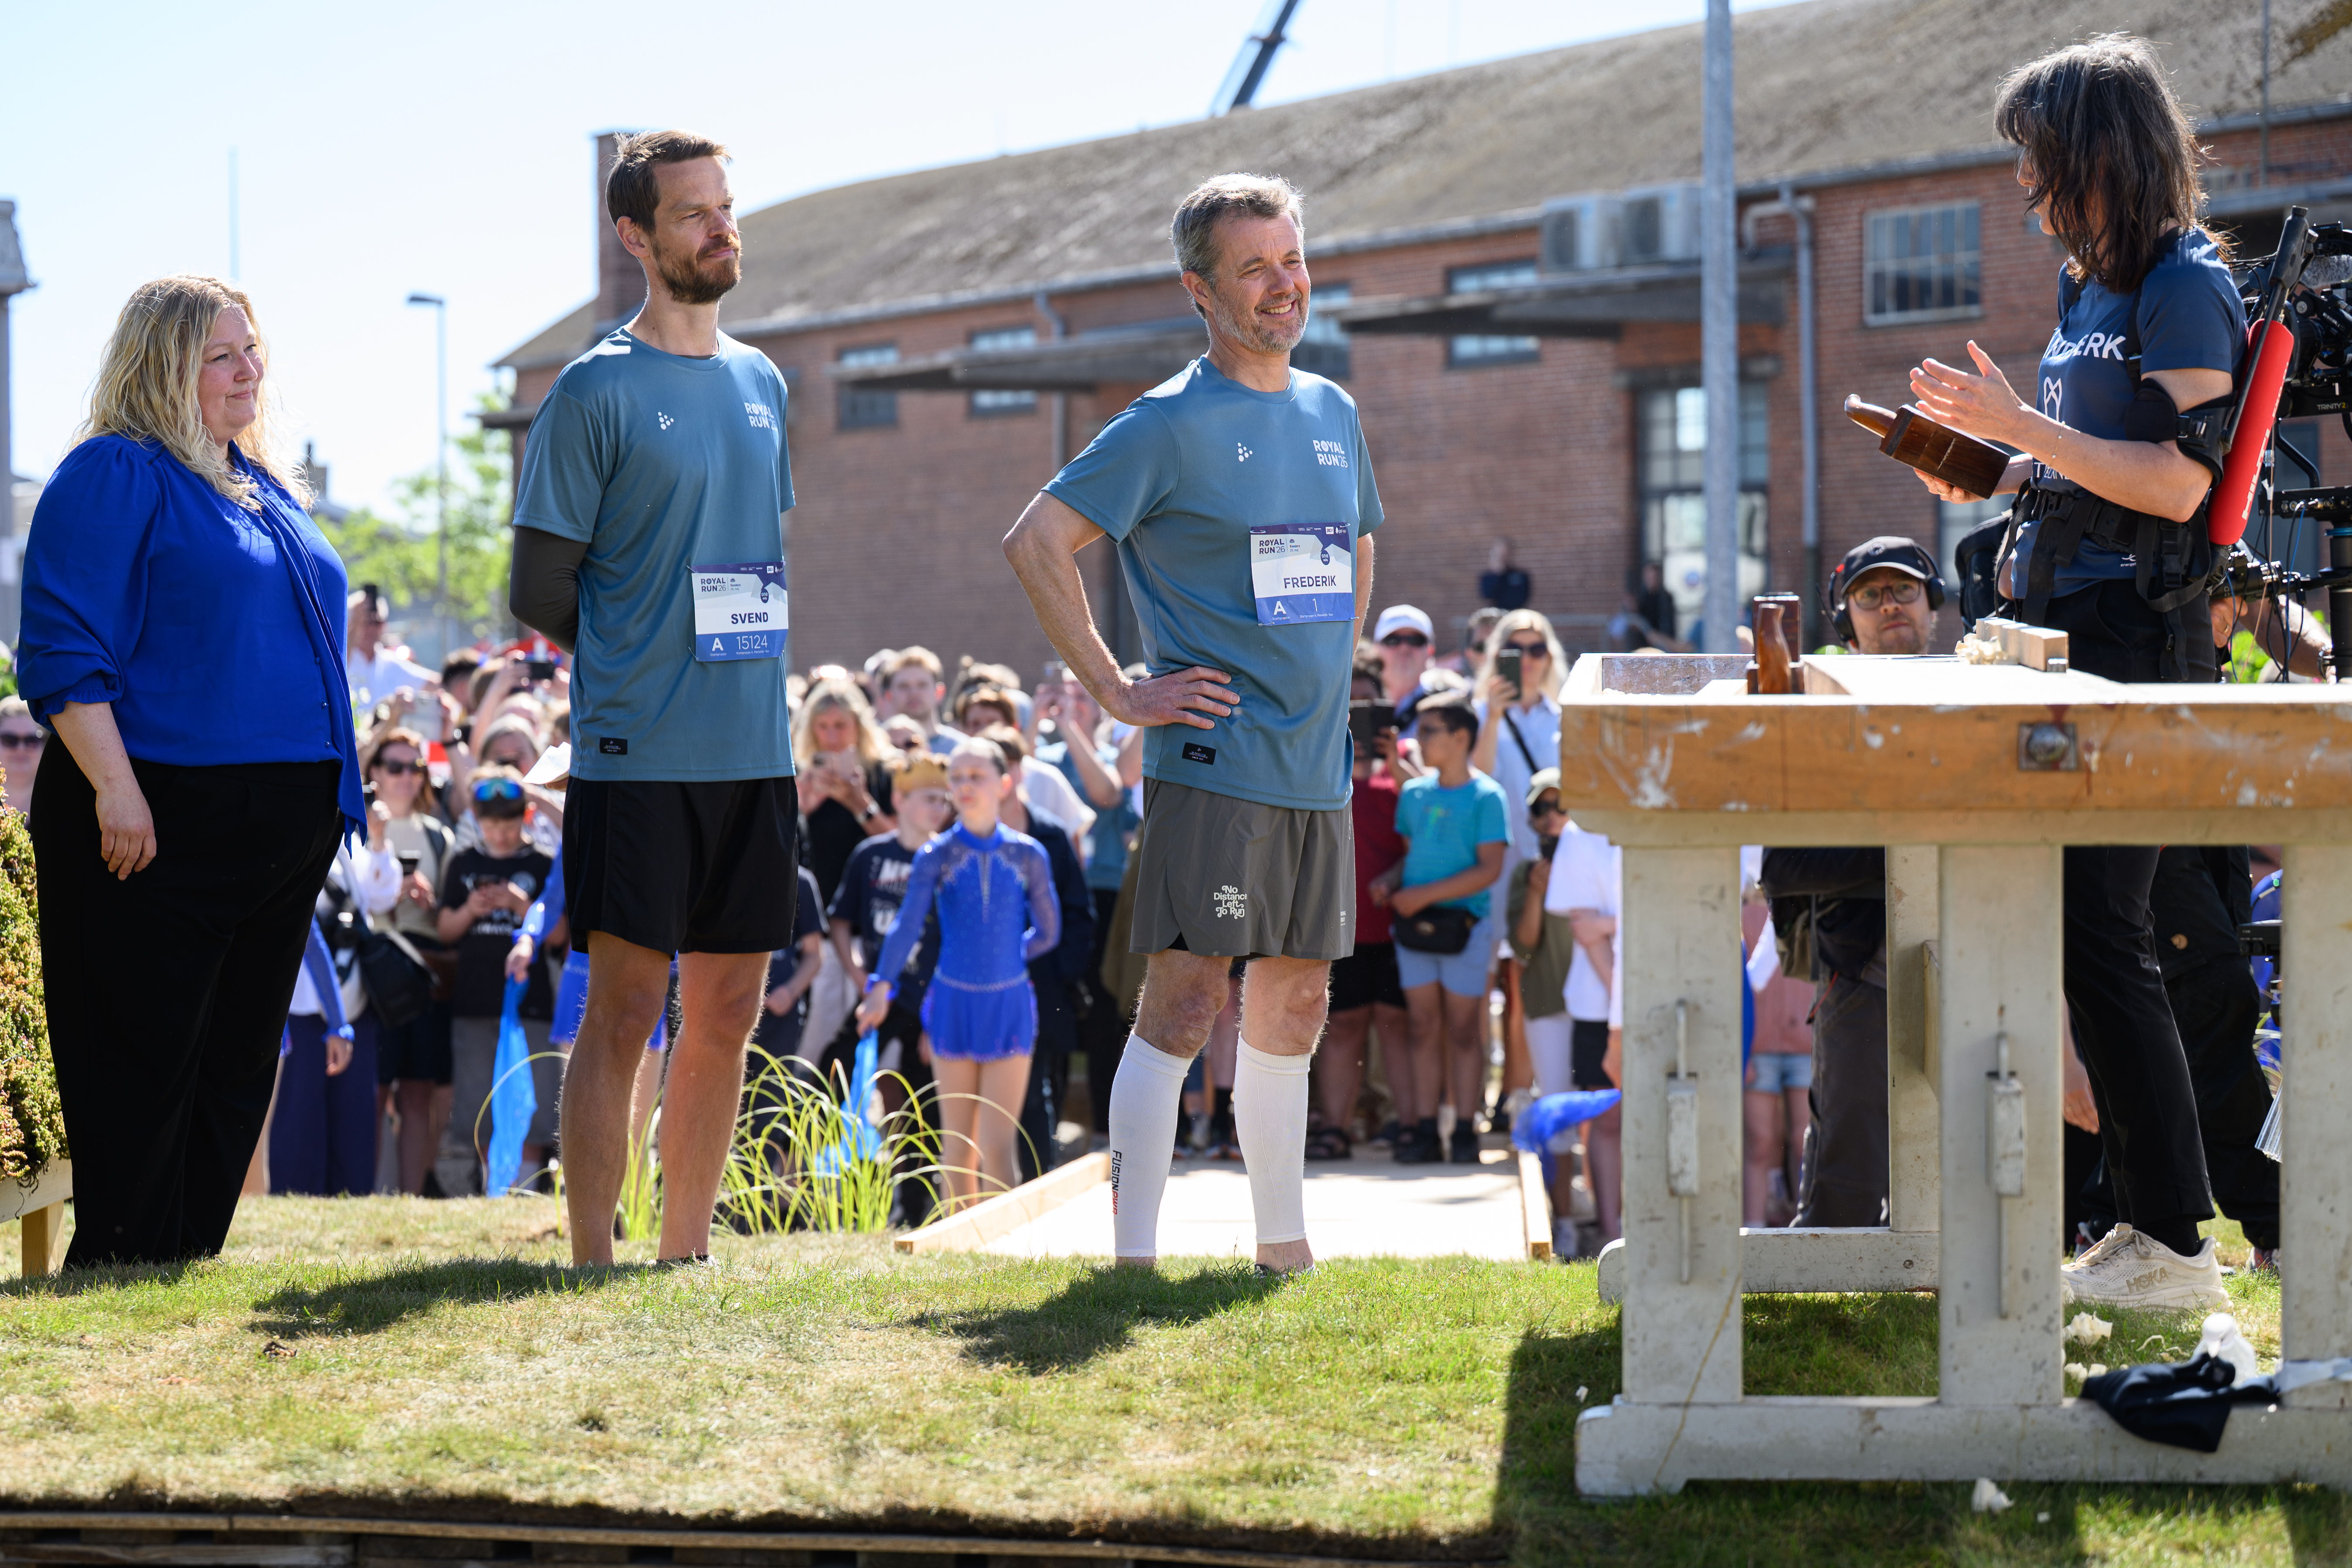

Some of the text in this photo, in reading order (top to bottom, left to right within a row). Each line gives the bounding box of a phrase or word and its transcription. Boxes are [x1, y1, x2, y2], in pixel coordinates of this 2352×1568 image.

[744, 402, 774, 419] ROYAL
[1312, 440, 1345, 455] ROYAL
[2241, 428, 2270, 520] HILTI
[1284, 575, 1337, 589] FREDERIK
[1274, 598, 1318, 615] A 1
[731, 612, 768, 624] SVEND
[712, 635, 768, 651] A 15124
[1214, 892, 1247, 900] Distance
[1222, 885, 1238, 894] No
[1222, 900, 1244, 908] Left
[1215, 907, 1245, 919] To Run
[2116, 1246, 2129, 1256] OKA
[2126, 1267, 2170, 1293] HOKA
